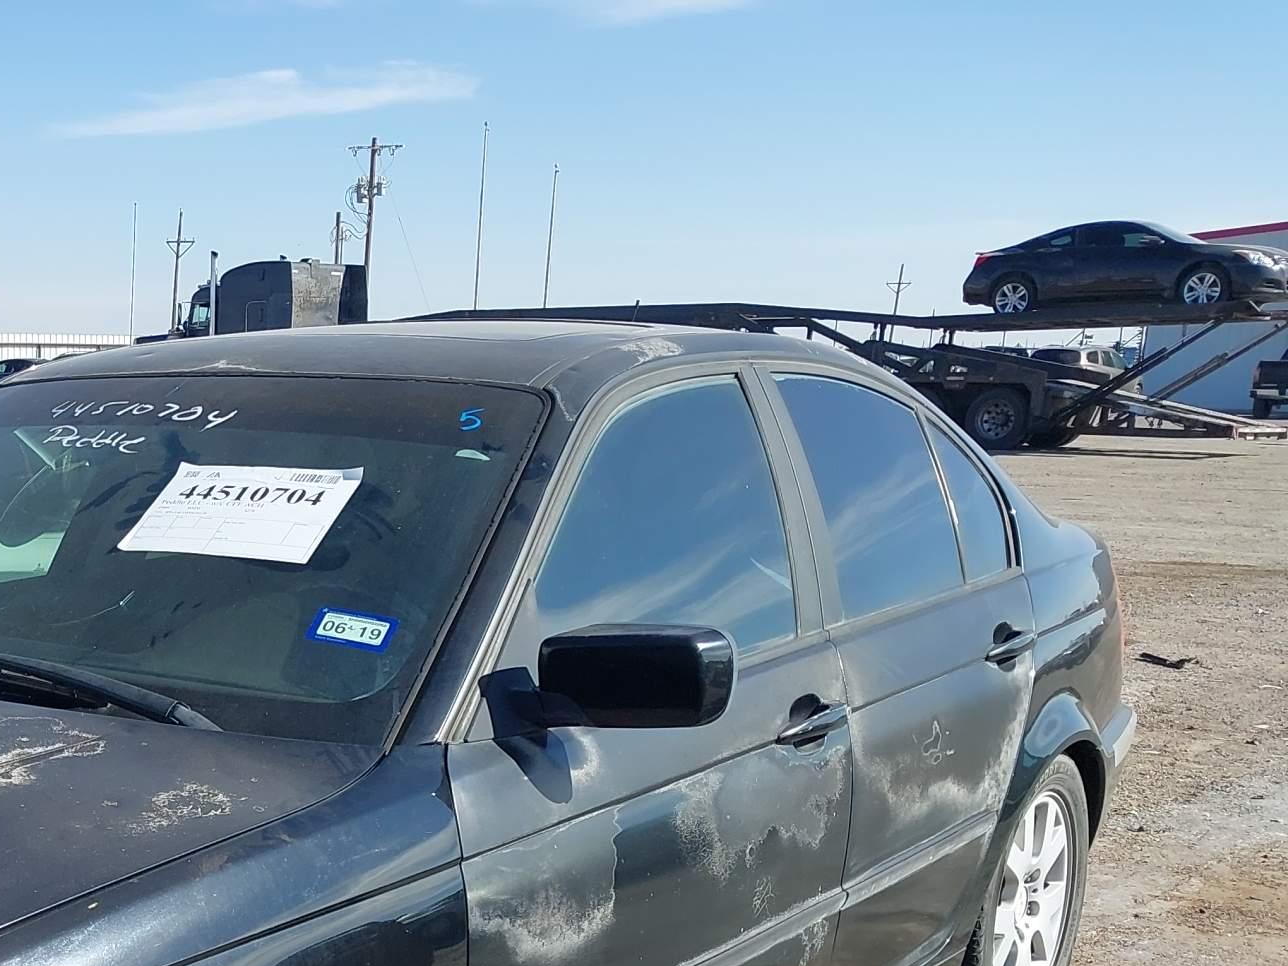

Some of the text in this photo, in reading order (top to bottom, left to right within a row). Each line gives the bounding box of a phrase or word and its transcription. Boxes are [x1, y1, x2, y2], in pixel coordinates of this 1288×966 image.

[51, 400, 238, 432] 44510704
[459, 407, 486, 431] 5
[178, 484, 326, 506] 44510704
[322, 620, 347, 634] 06
[359, 626, 382, 640] 19
